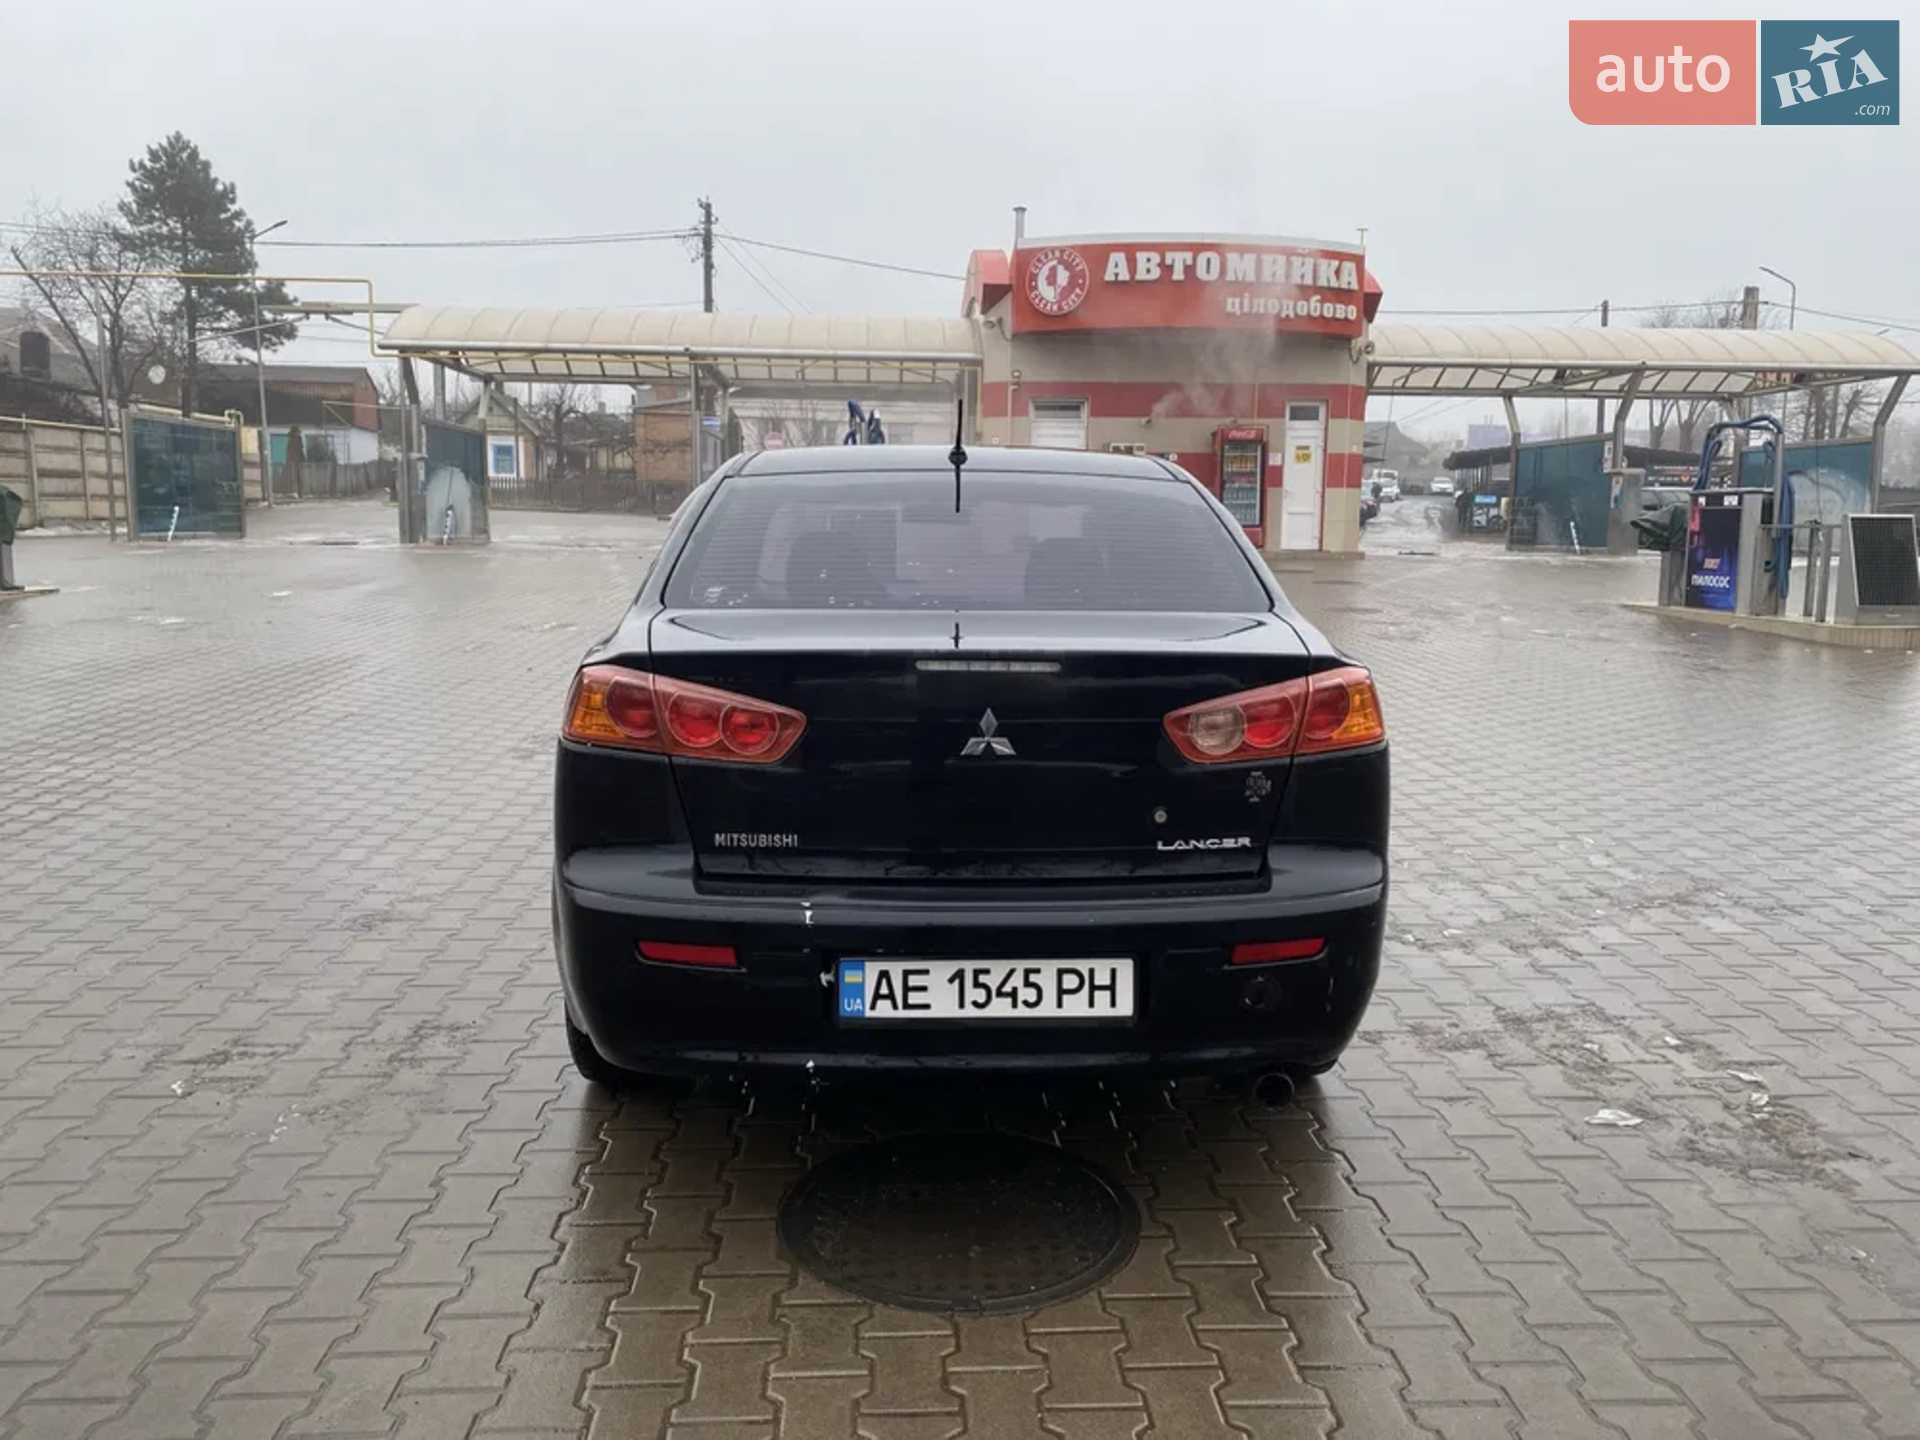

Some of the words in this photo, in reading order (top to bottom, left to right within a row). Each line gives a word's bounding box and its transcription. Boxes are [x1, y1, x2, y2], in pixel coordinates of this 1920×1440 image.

[1030, 249, 1061, 274] CLEAN
[1063, 250, 1084, 272] CITY
[1104, 249, 1359, 291] АВТОМИЙКА
[1225, 293, 1357, 321] цілодобово
[714, 832, 799, 848] MITSUBISHI
[1157, 837, 1252, 850] LANCER
[869, 968, 932, 1011] AE
[947, 967, 1044, 1010] 1545
[1056, 967, 1117, 1009] PH
[844, 997, 864, 1012] UA
